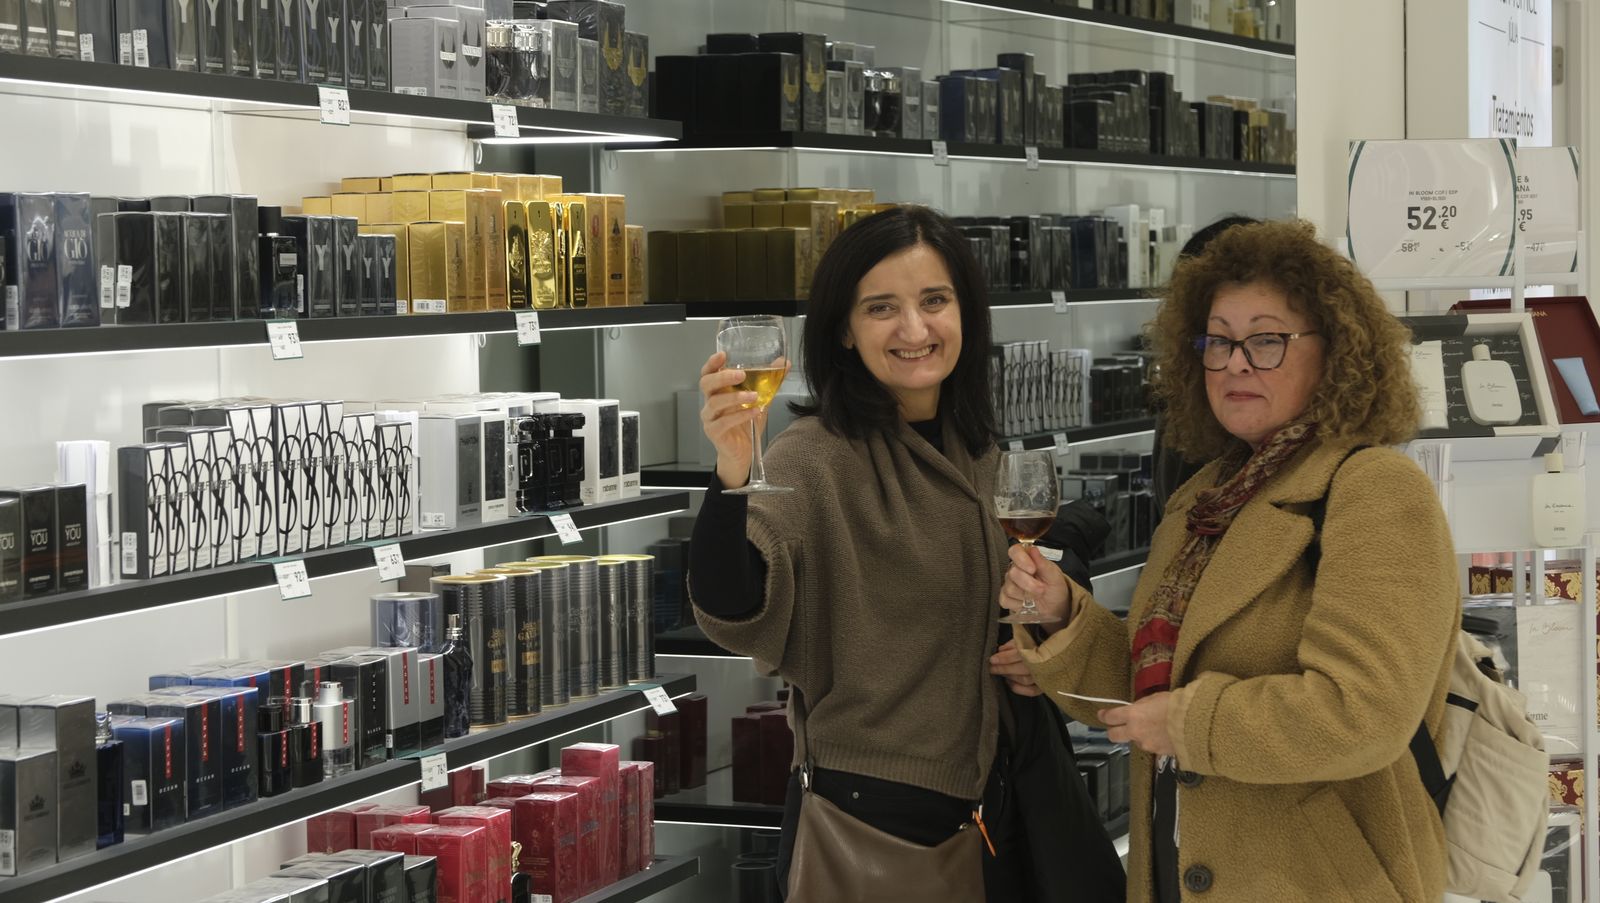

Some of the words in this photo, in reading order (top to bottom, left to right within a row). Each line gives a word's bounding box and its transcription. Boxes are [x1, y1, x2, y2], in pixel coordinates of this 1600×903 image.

[327, 16, 340, 43] Y
[350, 19, 363, 46] Y
[372, 23, 384, 49] Y
[1492, 95, 1534, 137] Tratamientos
[315, 244, 328, 271] Y
[342, 244, 354, 271] Y
[363, 257, 373, 279] Y
[382, 257, 392, 279] Y
[0, 535, 15, 551] OU
[30, 532, 48, 546] YOU
[65, 527, 81, 542] YOU
